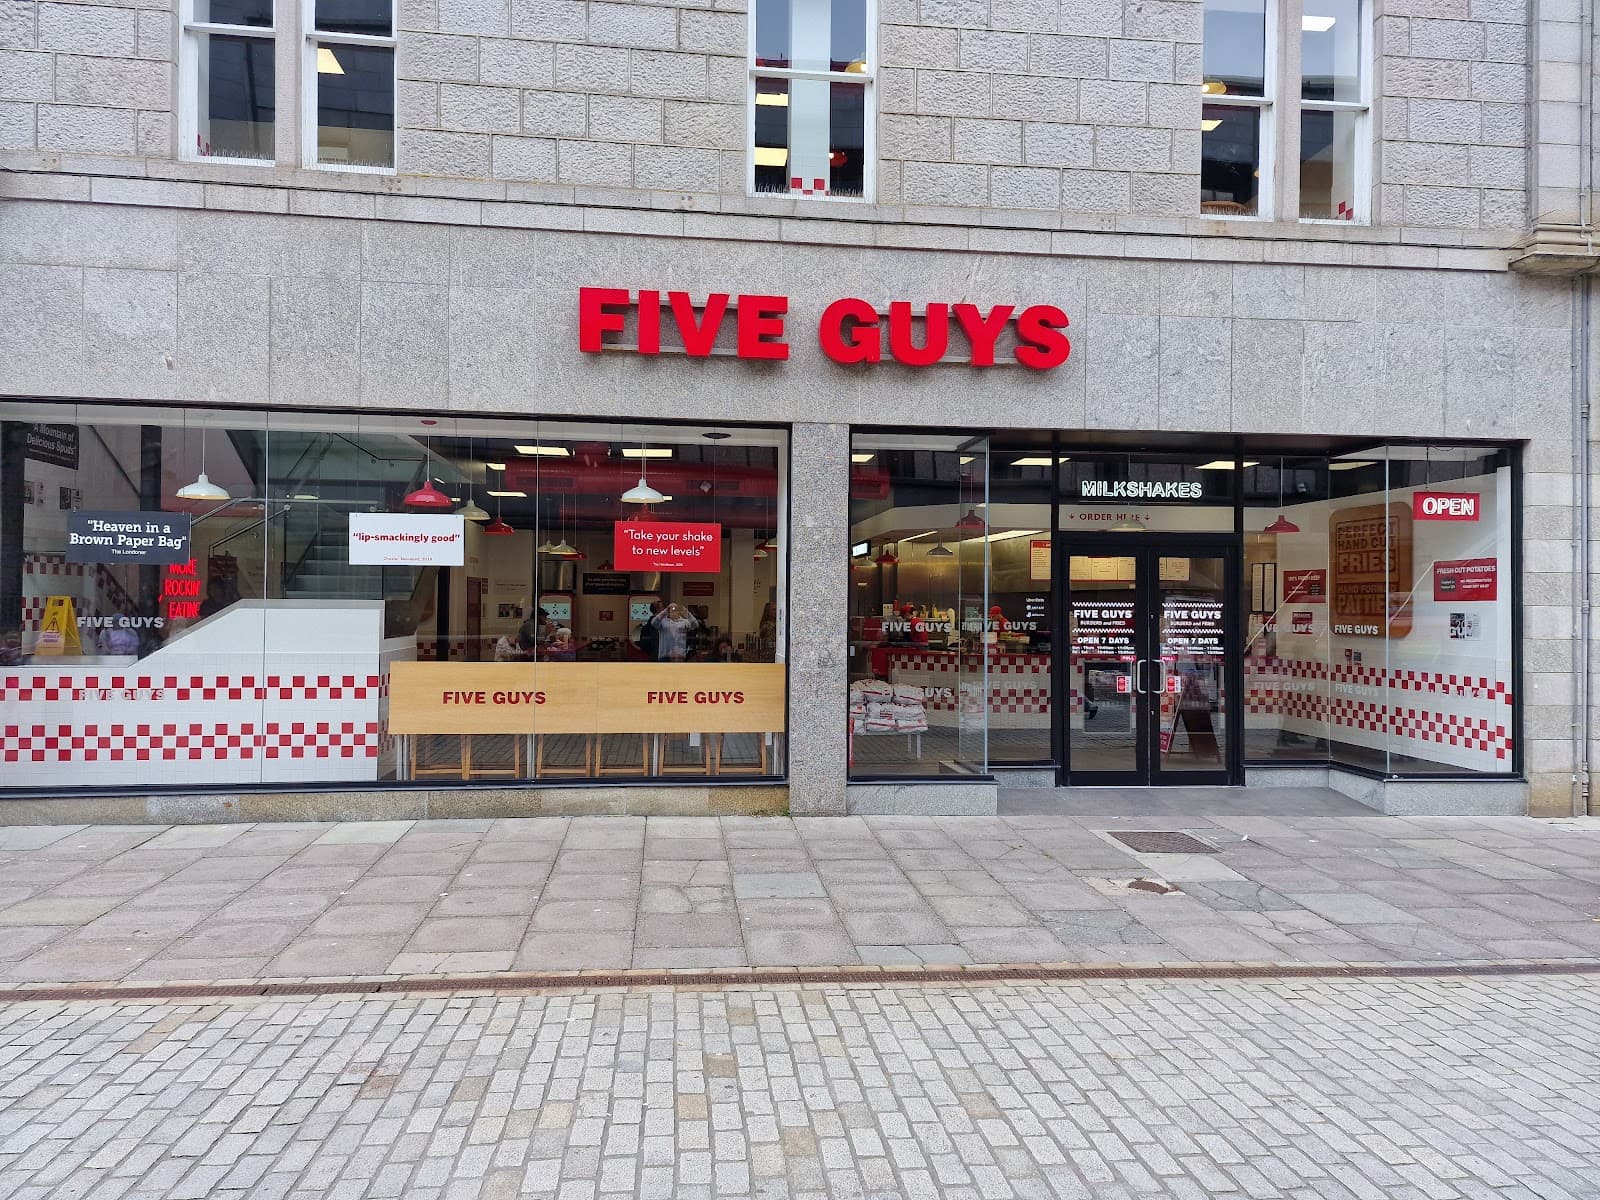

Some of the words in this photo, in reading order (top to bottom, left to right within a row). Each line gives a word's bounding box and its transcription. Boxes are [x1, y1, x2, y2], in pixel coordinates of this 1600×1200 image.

[579, 287, 789, 360] FIVE
[819, 297, 1071, 369] GUYS
[27, 433, 55, 450] Delicious
[1081, 480, 1203, 498] MILKSHAKES
[1422, 497, 1474, 516] OPEN
[1079, 513, 1112, 521] ORDER
[1116, 513, 1140, 521] HE
[88, 520, 142, 532] "Heaven
[146, 521, 160, 533] in
[163, 525, 171, 533] a
[69, 533, 113, 545] Brown
[117, 534, 154, 548] Paper
[158, 535, 187, 549] Bag"
[353, 532, 429, 543] "lip-smackingly
[431, 533, 460, 543] good"
[624, 528, 653, 540] "Take
[656, 533, 680, 543] your
[682, 530, 713, 541] shake
[632, 545, 643, 555] to
[646, 547, 668, 555] new
[671, 545, 704, 556] levels"
[1338, 538, 1368, 551] HAND
[1339, 550, 1395, 573] FRIES
[1338, 594, 1386, 615] PATTIE
[1073, 609, 1099, 619] FIVE
[1101, 609, 1133, 619] GUYS
[1163, 610, 1189, 619] FIVE
[1190, 610, 1221, 619] GUYS
[77, 616, 113, 628] FIVE
[118, 616, 164, 628] GUYS
[881, 621, 912, 632] FIVE
[915, 621, 952, 632] GUYS
[1003, 621, 1037, 630] GUYS
[1334, 624, 1353, 634] FIVE
[1354, 625, 1379, 635] GUYS
[1077, 636, 1099, 644] OPEN
[1167, 637, 1189, 645] OPEN
[1198, 637, 1219, 645] DAYS
[442, 691, 487, 705] FIVE
[492, 691, 546, 705] GUYS
[647, 691, 688, 704] FIVE
[694, 691, 745, 704] GUYS
